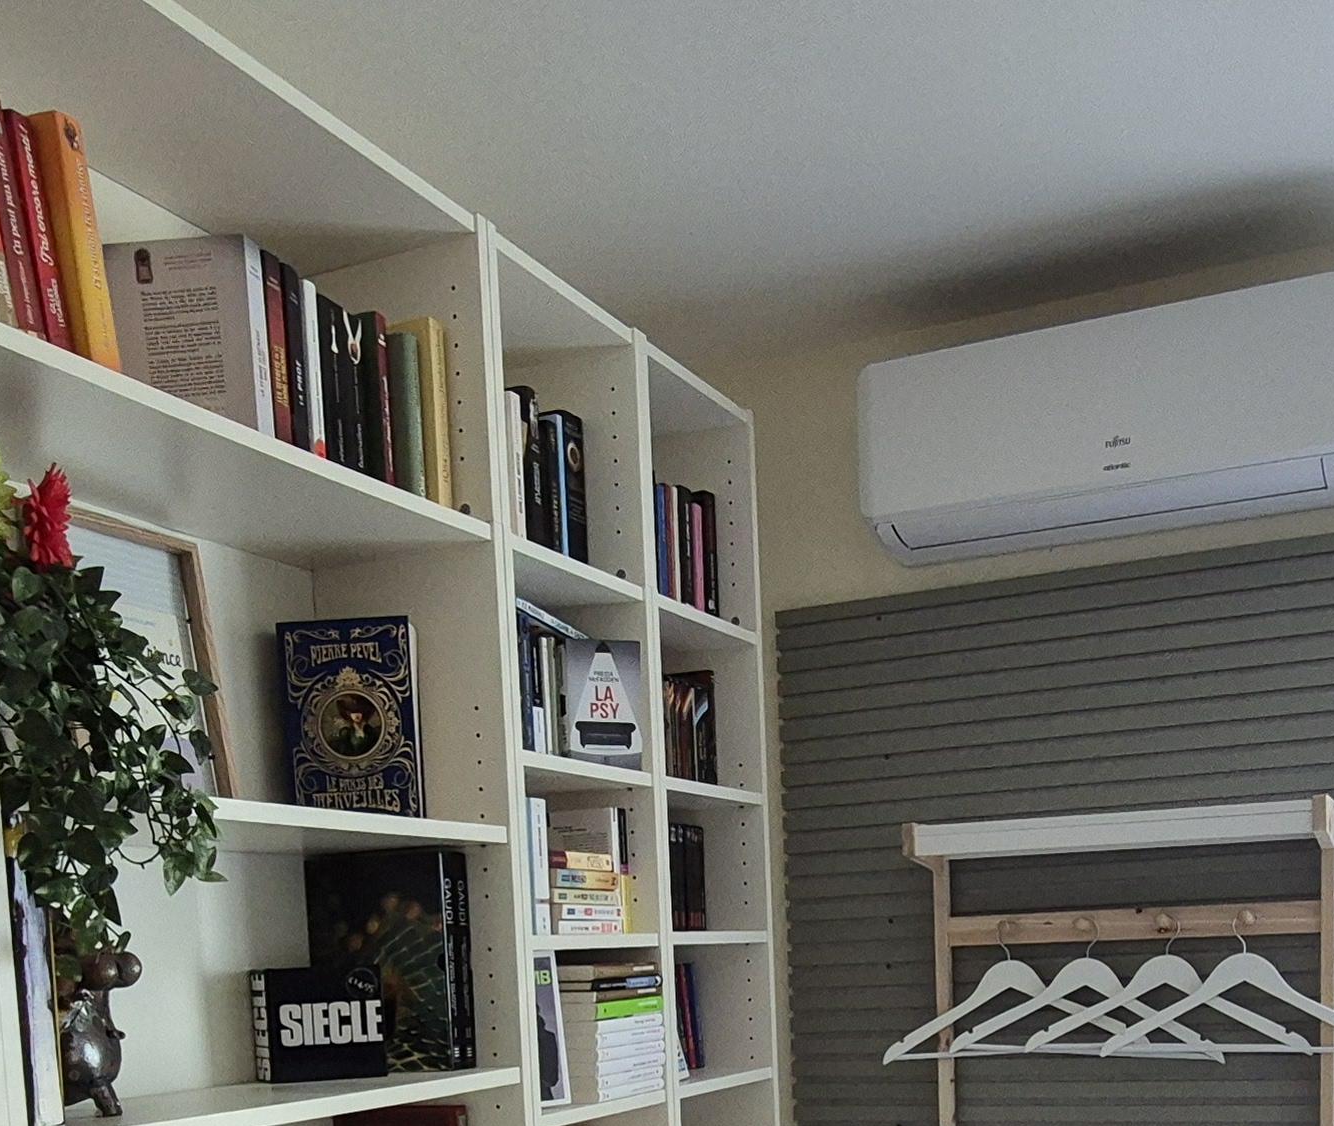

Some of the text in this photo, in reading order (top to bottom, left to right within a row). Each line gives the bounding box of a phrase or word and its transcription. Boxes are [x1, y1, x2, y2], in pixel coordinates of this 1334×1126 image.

[2, 183, 17, 207] pas
[7, 209, 23, 237] peut
[1104, 435, 1131, 449] FUJITSU
[310, 642, 382, 667] PIERRE PEVEL
[595, 685, 614, 702] LA
[590, 703, 619, 719] PSY
[326, 775, 338, 792] LE
[368, 773, 384, 790] DES
[279, 999, 384, 1047] SIECLE
